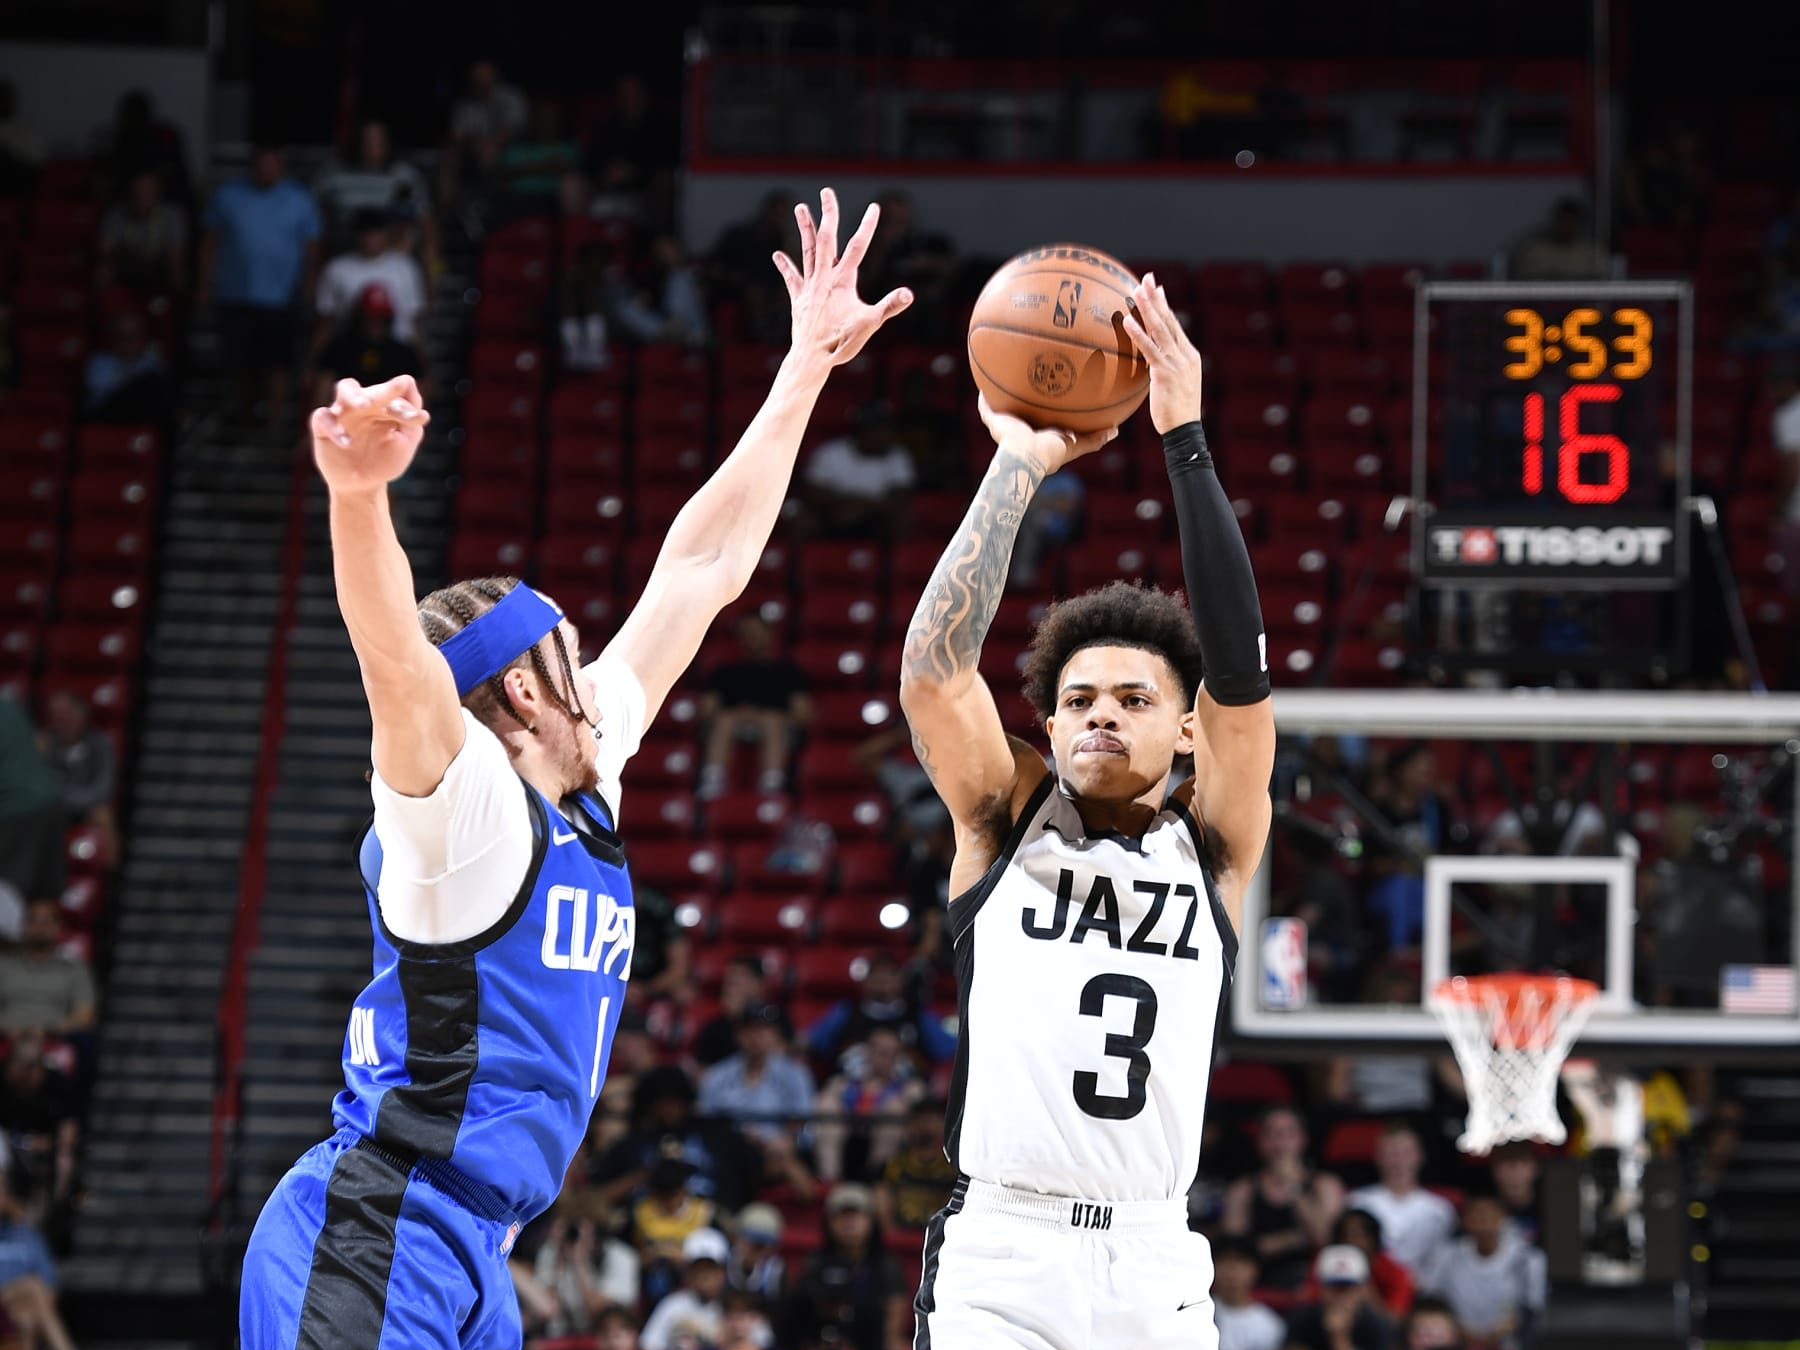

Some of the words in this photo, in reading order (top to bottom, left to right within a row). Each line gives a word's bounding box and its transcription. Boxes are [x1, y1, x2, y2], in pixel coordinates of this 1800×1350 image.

[1503, 308, 1653, 380] 3:53
[1521, 383, 1631, 504] 16
[1497, 526, 1673, 566] TISSOT
[1022, 868, 1200, 961] JAZZ
[590, 996, 610, 1098] 1
[1072, 972, 1158, 1121] 3
[1071, 1202, 1113, 1231] UTAH
